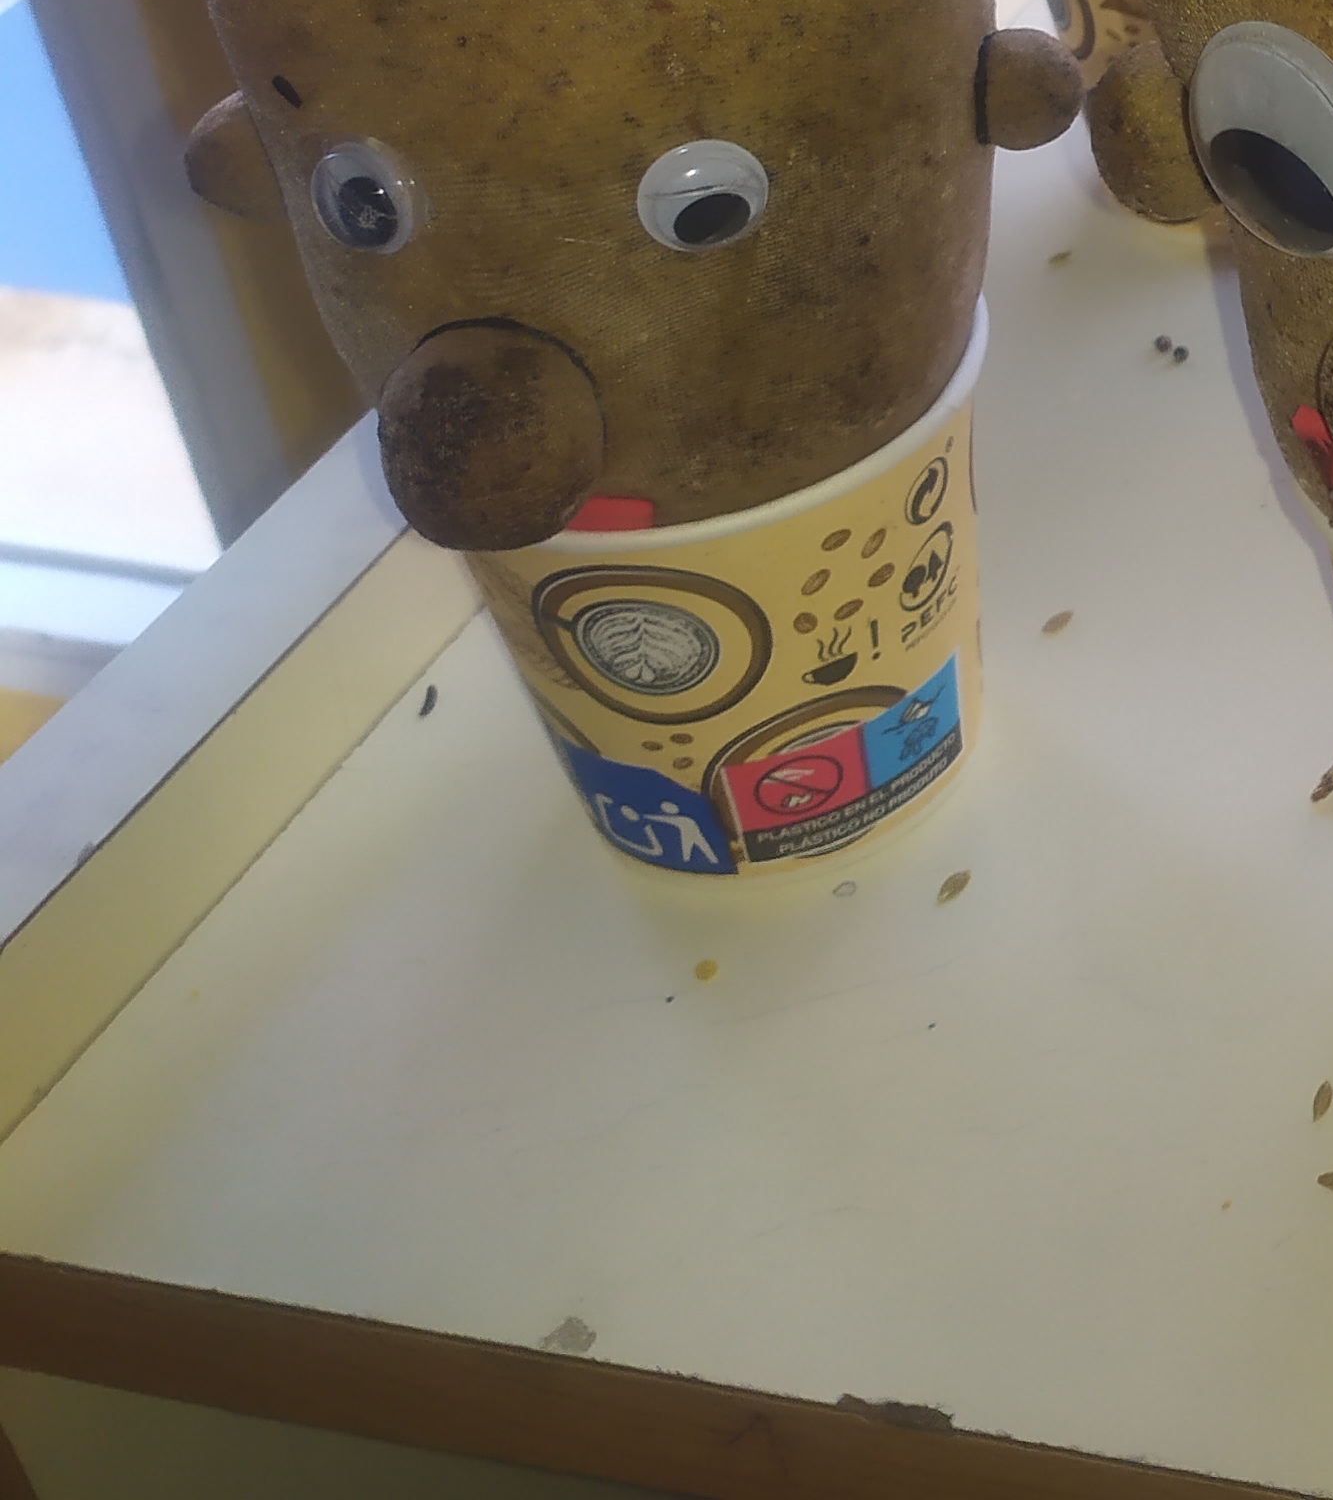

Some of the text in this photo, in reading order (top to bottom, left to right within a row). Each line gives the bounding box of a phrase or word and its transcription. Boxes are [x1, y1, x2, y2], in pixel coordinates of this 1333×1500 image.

[901, 575, 958, 643] PEFC
[844, 799, 867, 816] EN
[868, 789, 889, 804] EL
[890, 733, 956, 791] PRODUCTO
[863, 805, 885, 823] NO
[888, 758, 948, 809] PRODUTO
